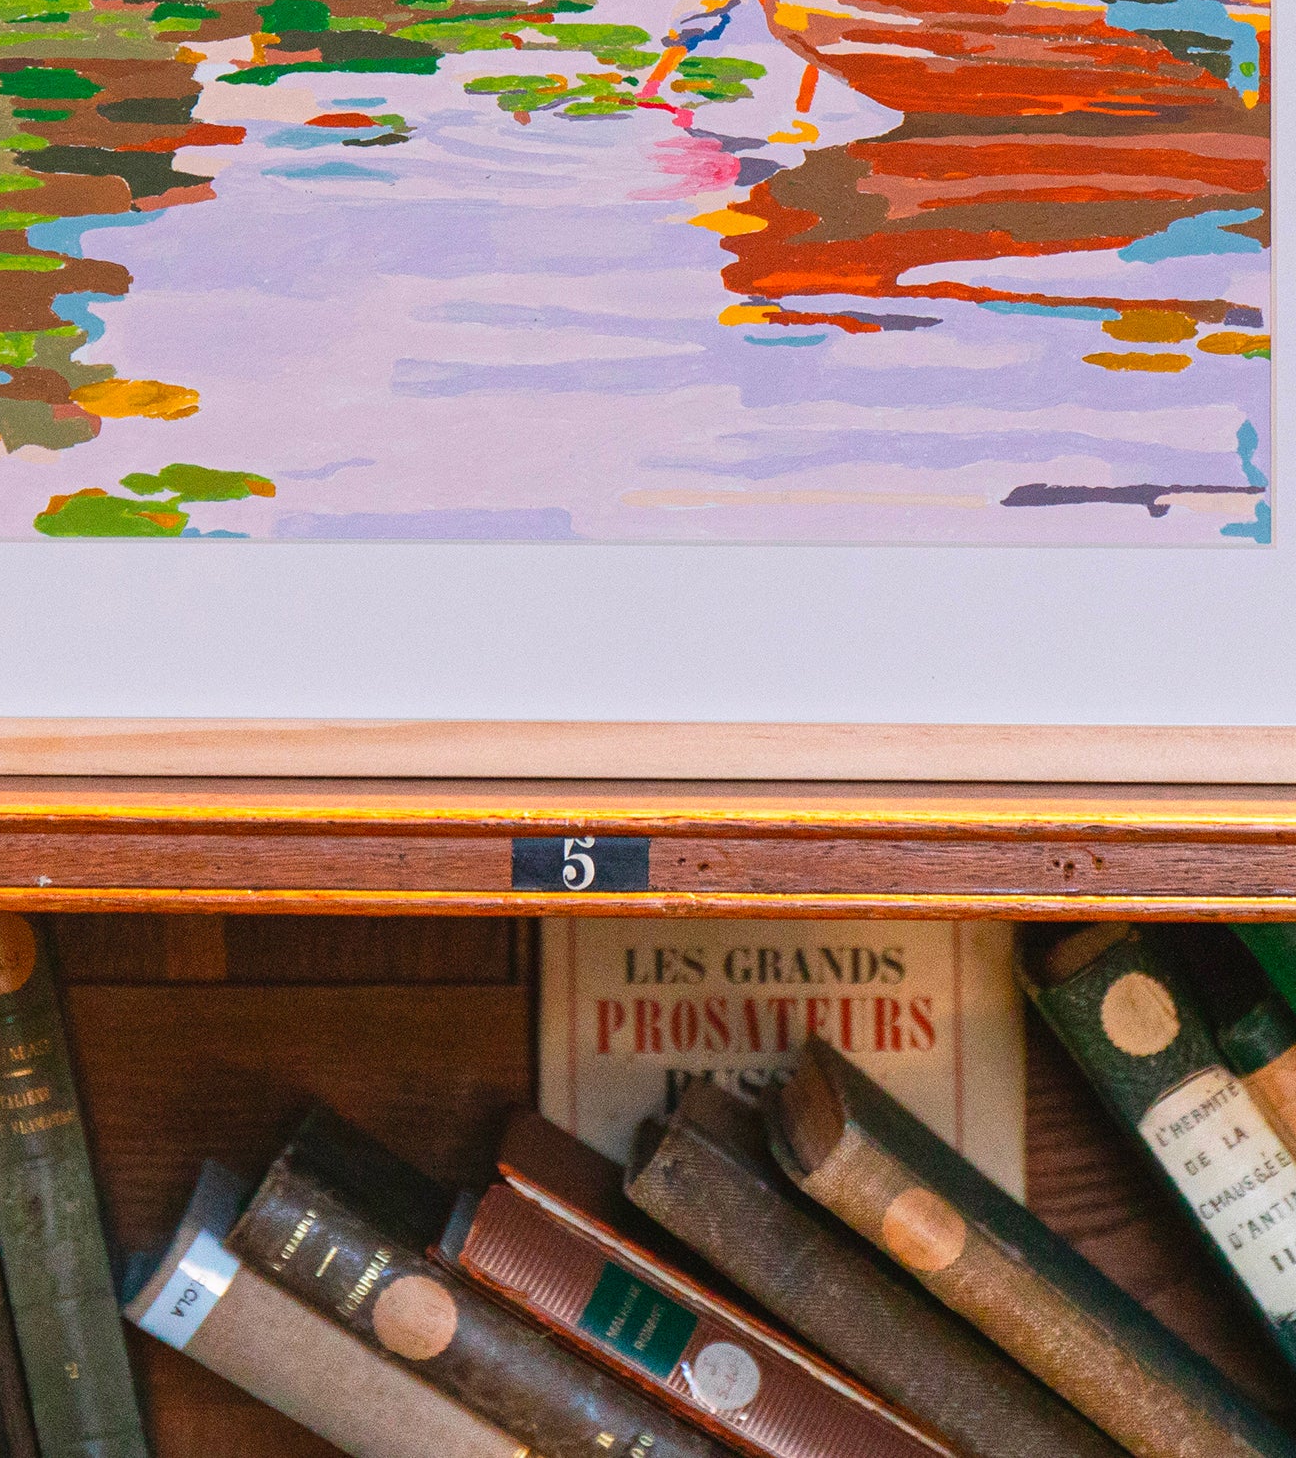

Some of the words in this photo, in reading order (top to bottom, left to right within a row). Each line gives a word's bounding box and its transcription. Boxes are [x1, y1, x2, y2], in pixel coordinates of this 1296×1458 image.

[562, 838, 595, 890] 5
[625, 949, 704, 985] LES
[723, 946, 907, 984] GRANDS
[596, 997, 937, 1054] PROSATEURS
[1154, 1081, 1240, 1149] L'HERMITE
[1184, 1151, 1212, 1178] DE
[1222, 1124, 1250, 1148] LA
[1198, 1149, 1292, 1222] CHAUSSÉE
